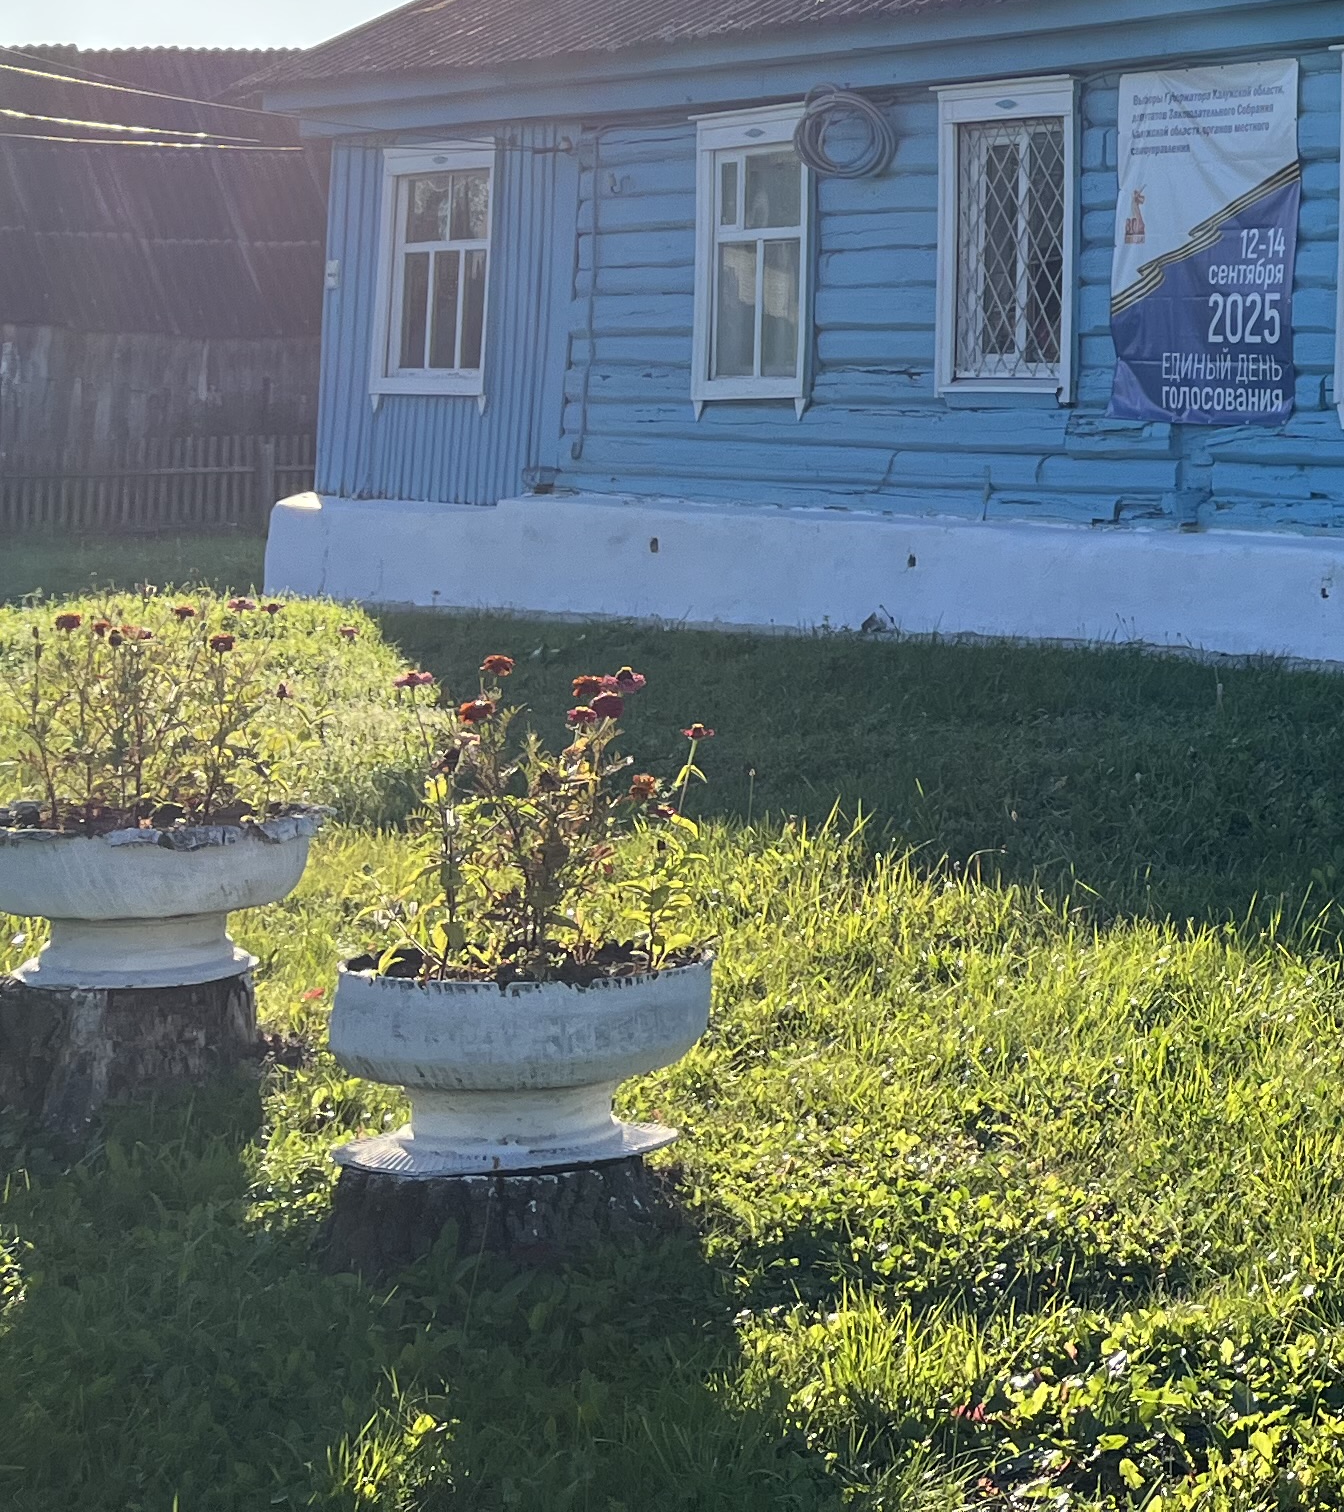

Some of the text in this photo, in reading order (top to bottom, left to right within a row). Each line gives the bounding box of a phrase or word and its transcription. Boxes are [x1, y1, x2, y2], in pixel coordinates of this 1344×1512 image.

[1240, 227, 1286, 259] 12-14
[1208, 258, 1285, 291] сентября
[1207, 292, 1281, 344] 2025
[1161, 347, 1283, 385] ЕДИНЫЙ ДЕНЬ
